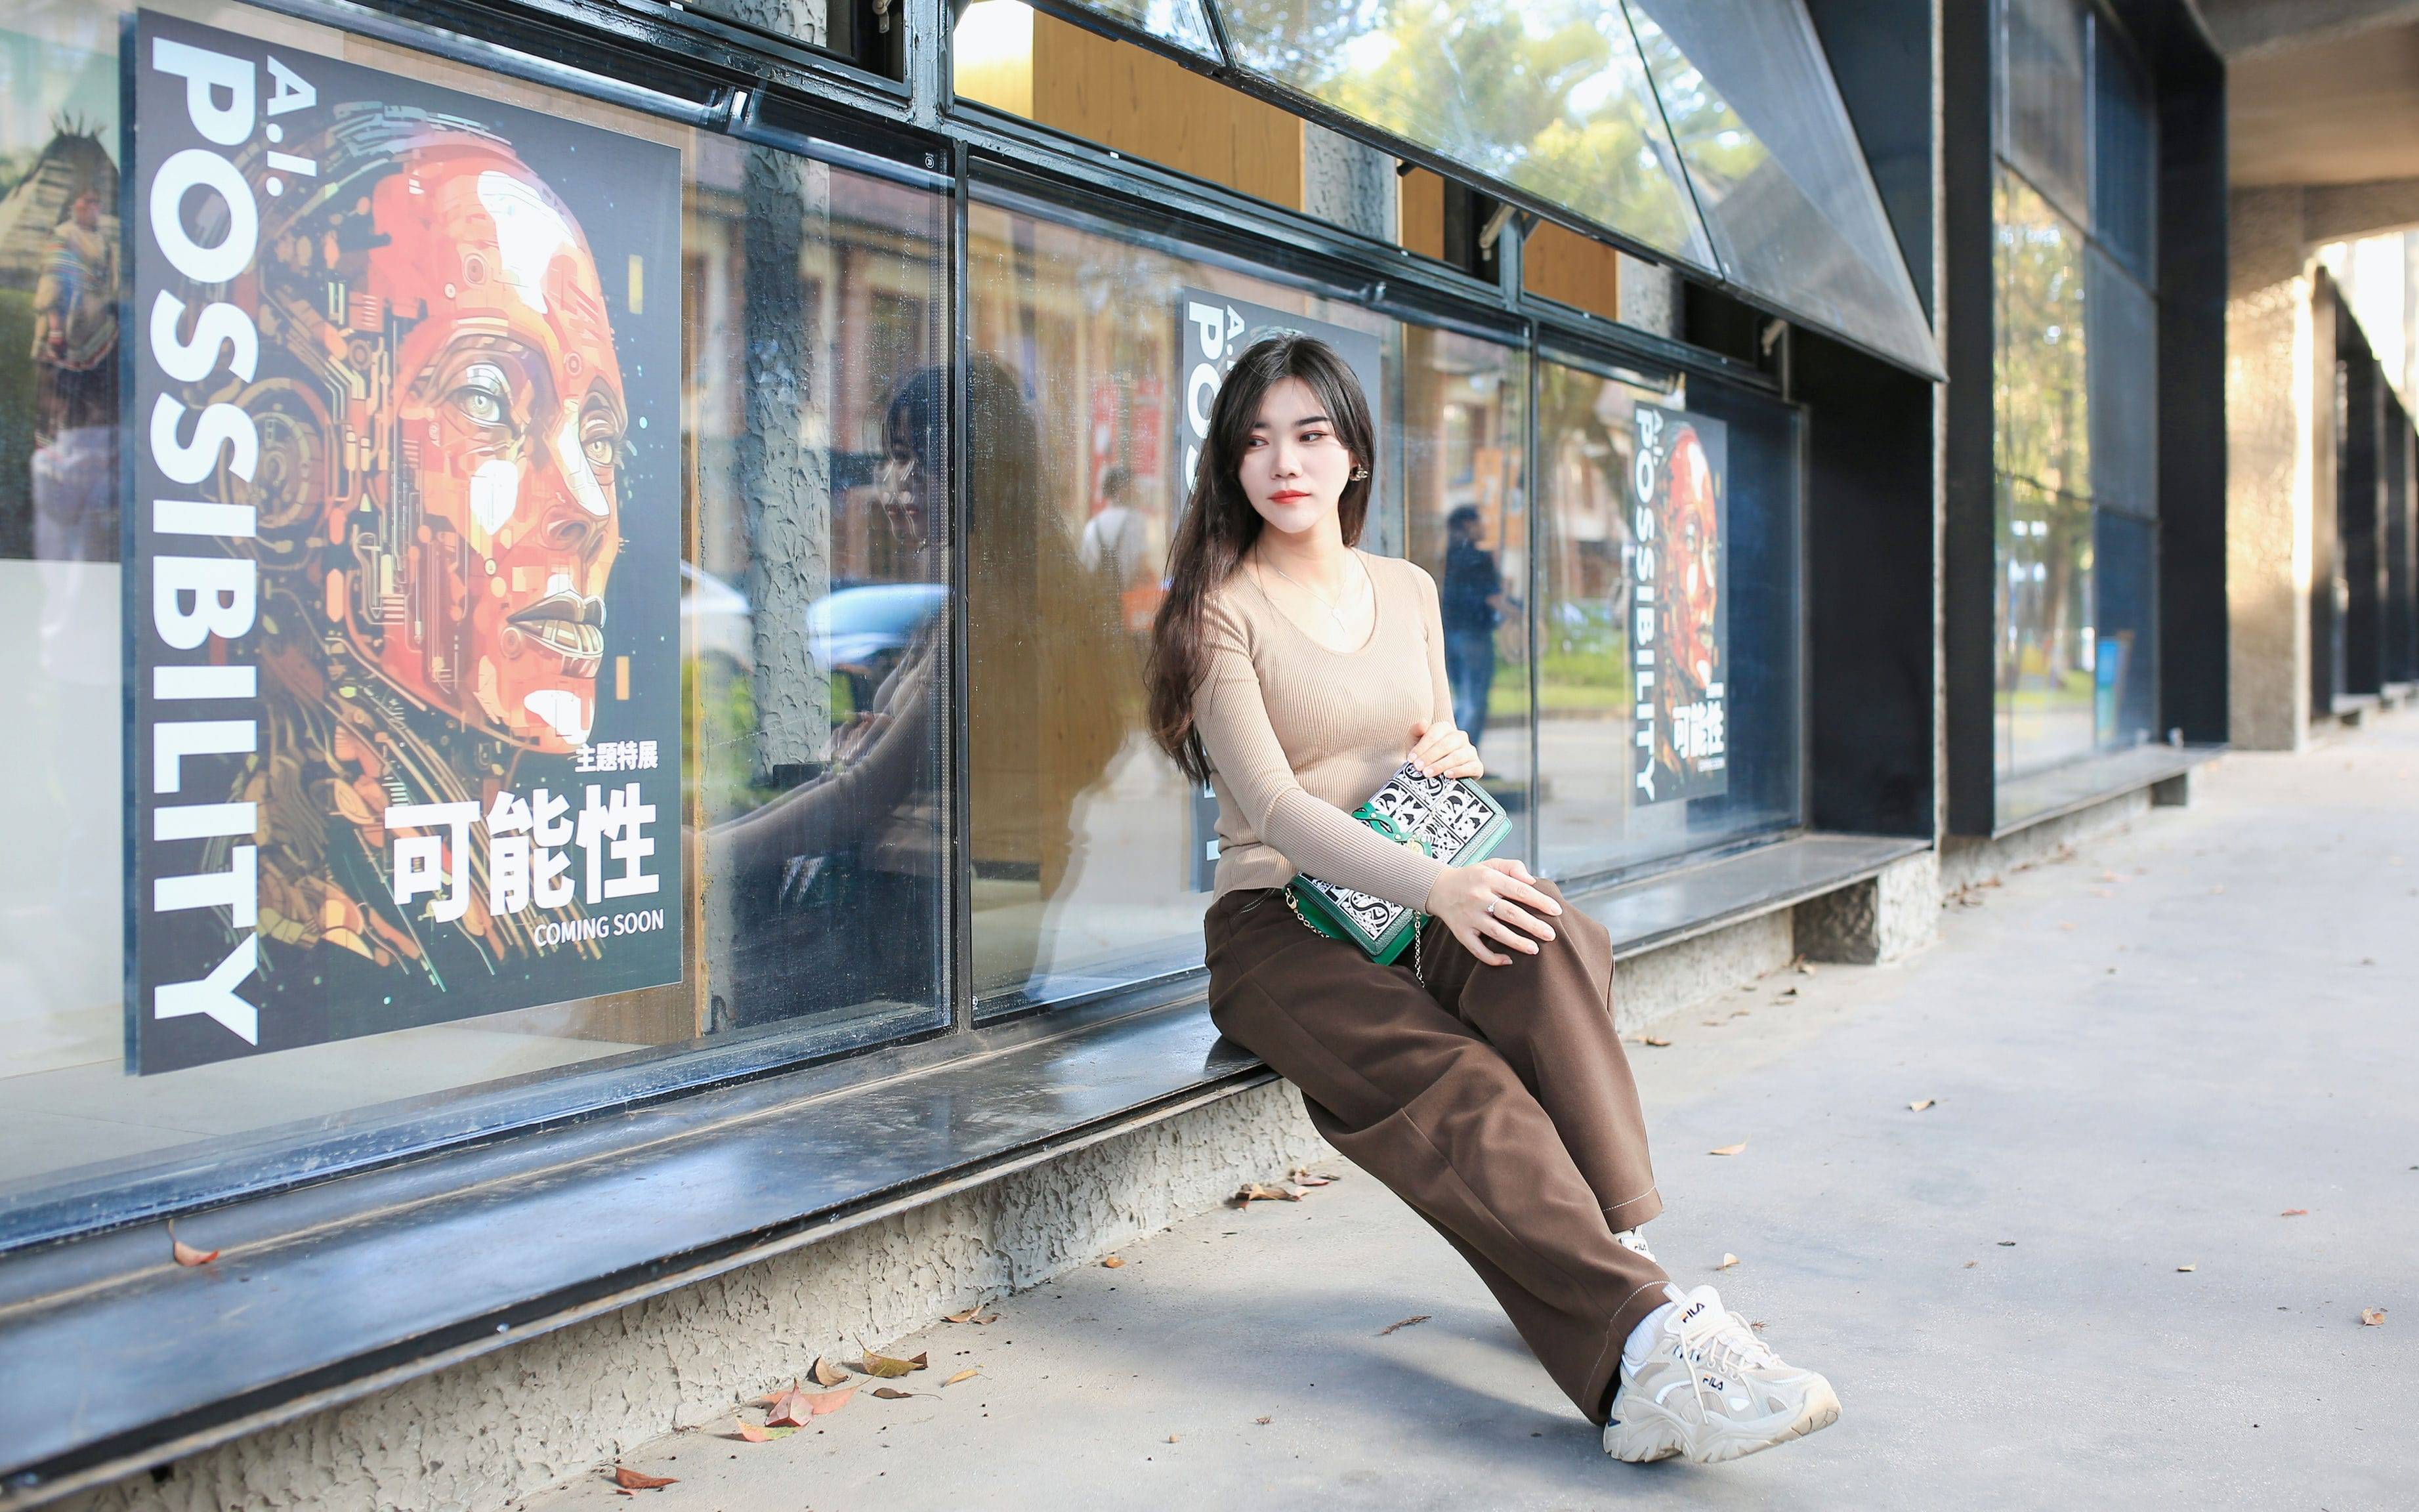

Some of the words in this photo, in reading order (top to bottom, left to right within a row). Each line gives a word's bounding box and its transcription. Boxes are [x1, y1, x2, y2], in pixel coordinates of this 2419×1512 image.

[266, 54, 317, 197] A.I.
[150, 37, 259, 1046] POSSIBILITY
[1635, 408, 1655, 802] POSSIBILITY
[574, 740, 659, 773] 主题特展
[384, 782, 660, 924] 可能性
[534, 916, 609, 947] COMING
[613, 908, 664, 936] SOON
[1680, 1301, 1706, 1324] FILA
[1702, 1374, 1724, 1391] FILA
